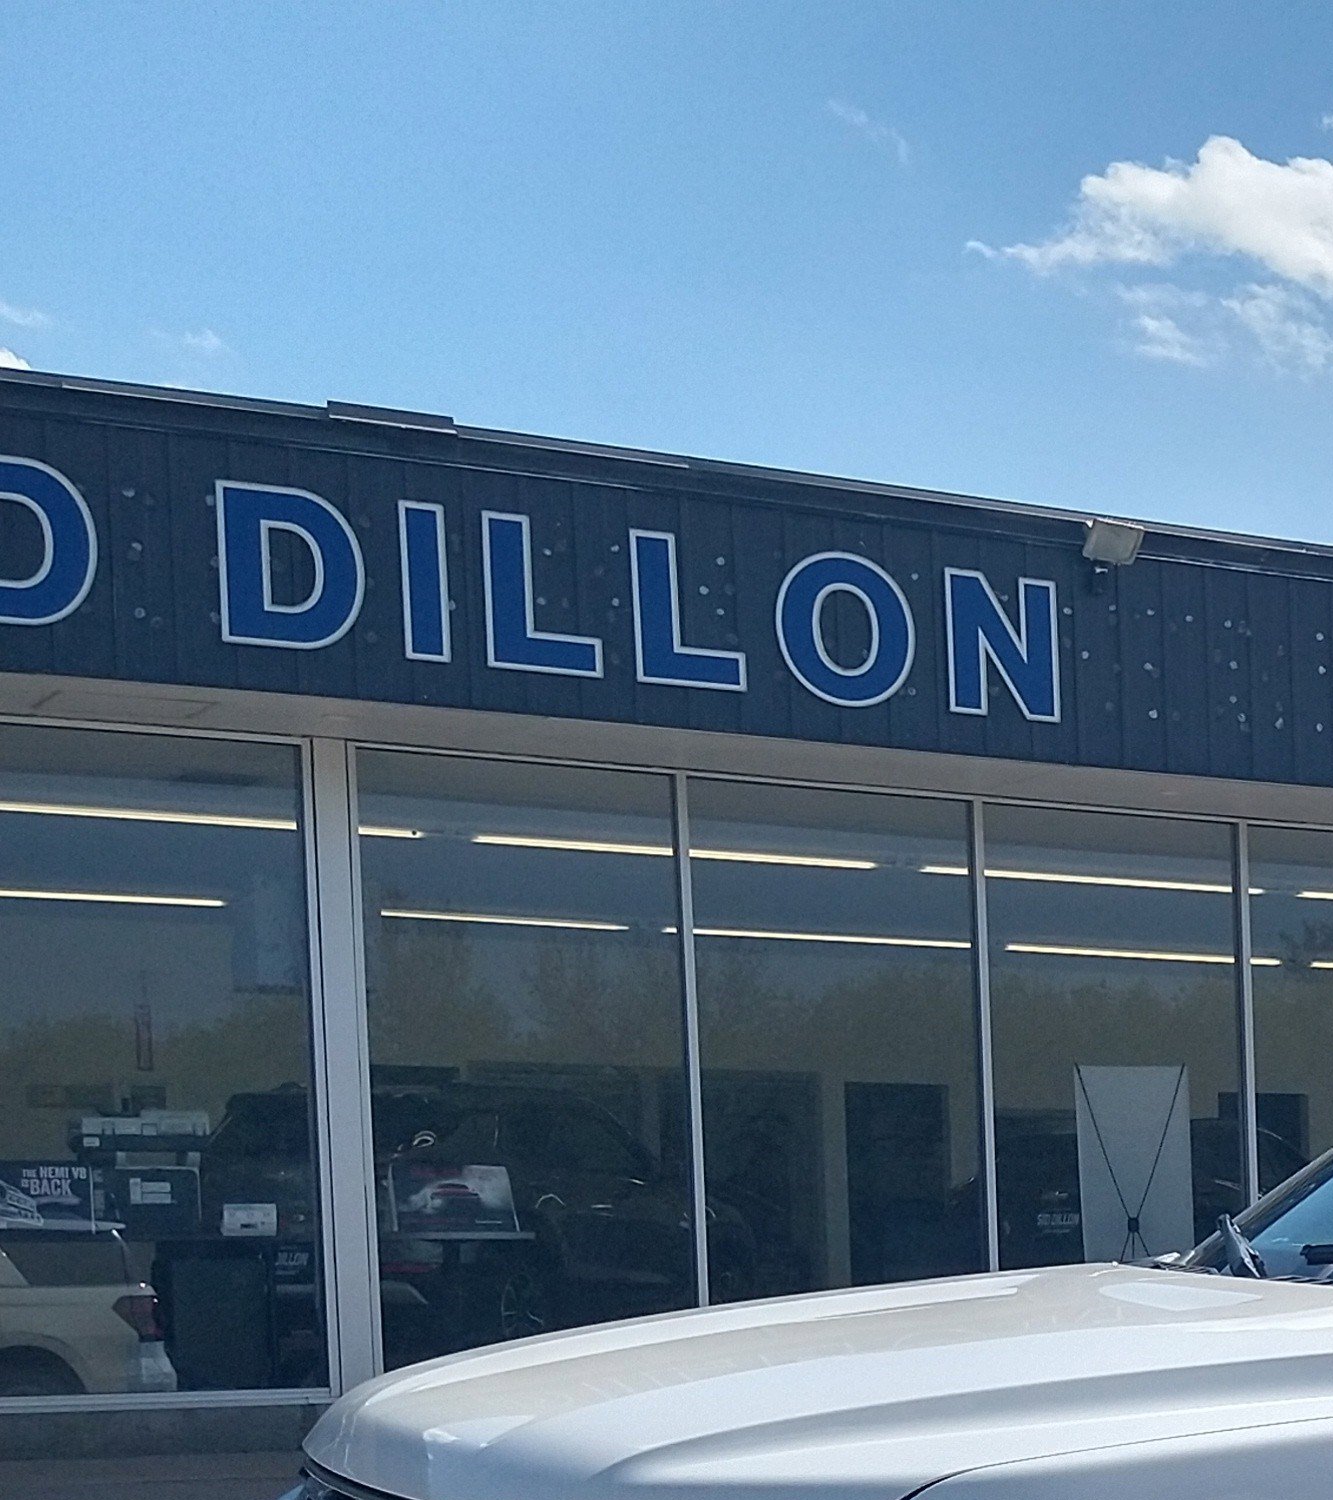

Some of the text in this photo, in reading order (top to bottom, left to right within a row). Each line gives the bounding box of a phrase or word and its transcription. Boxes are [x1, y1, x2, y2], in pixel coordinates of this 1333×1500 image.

[213, 479, 1061, 723] DILLON
[22, 1166, 87, 1179] THE HEMI V8
[30, 1179, 72, 1196] BACK
